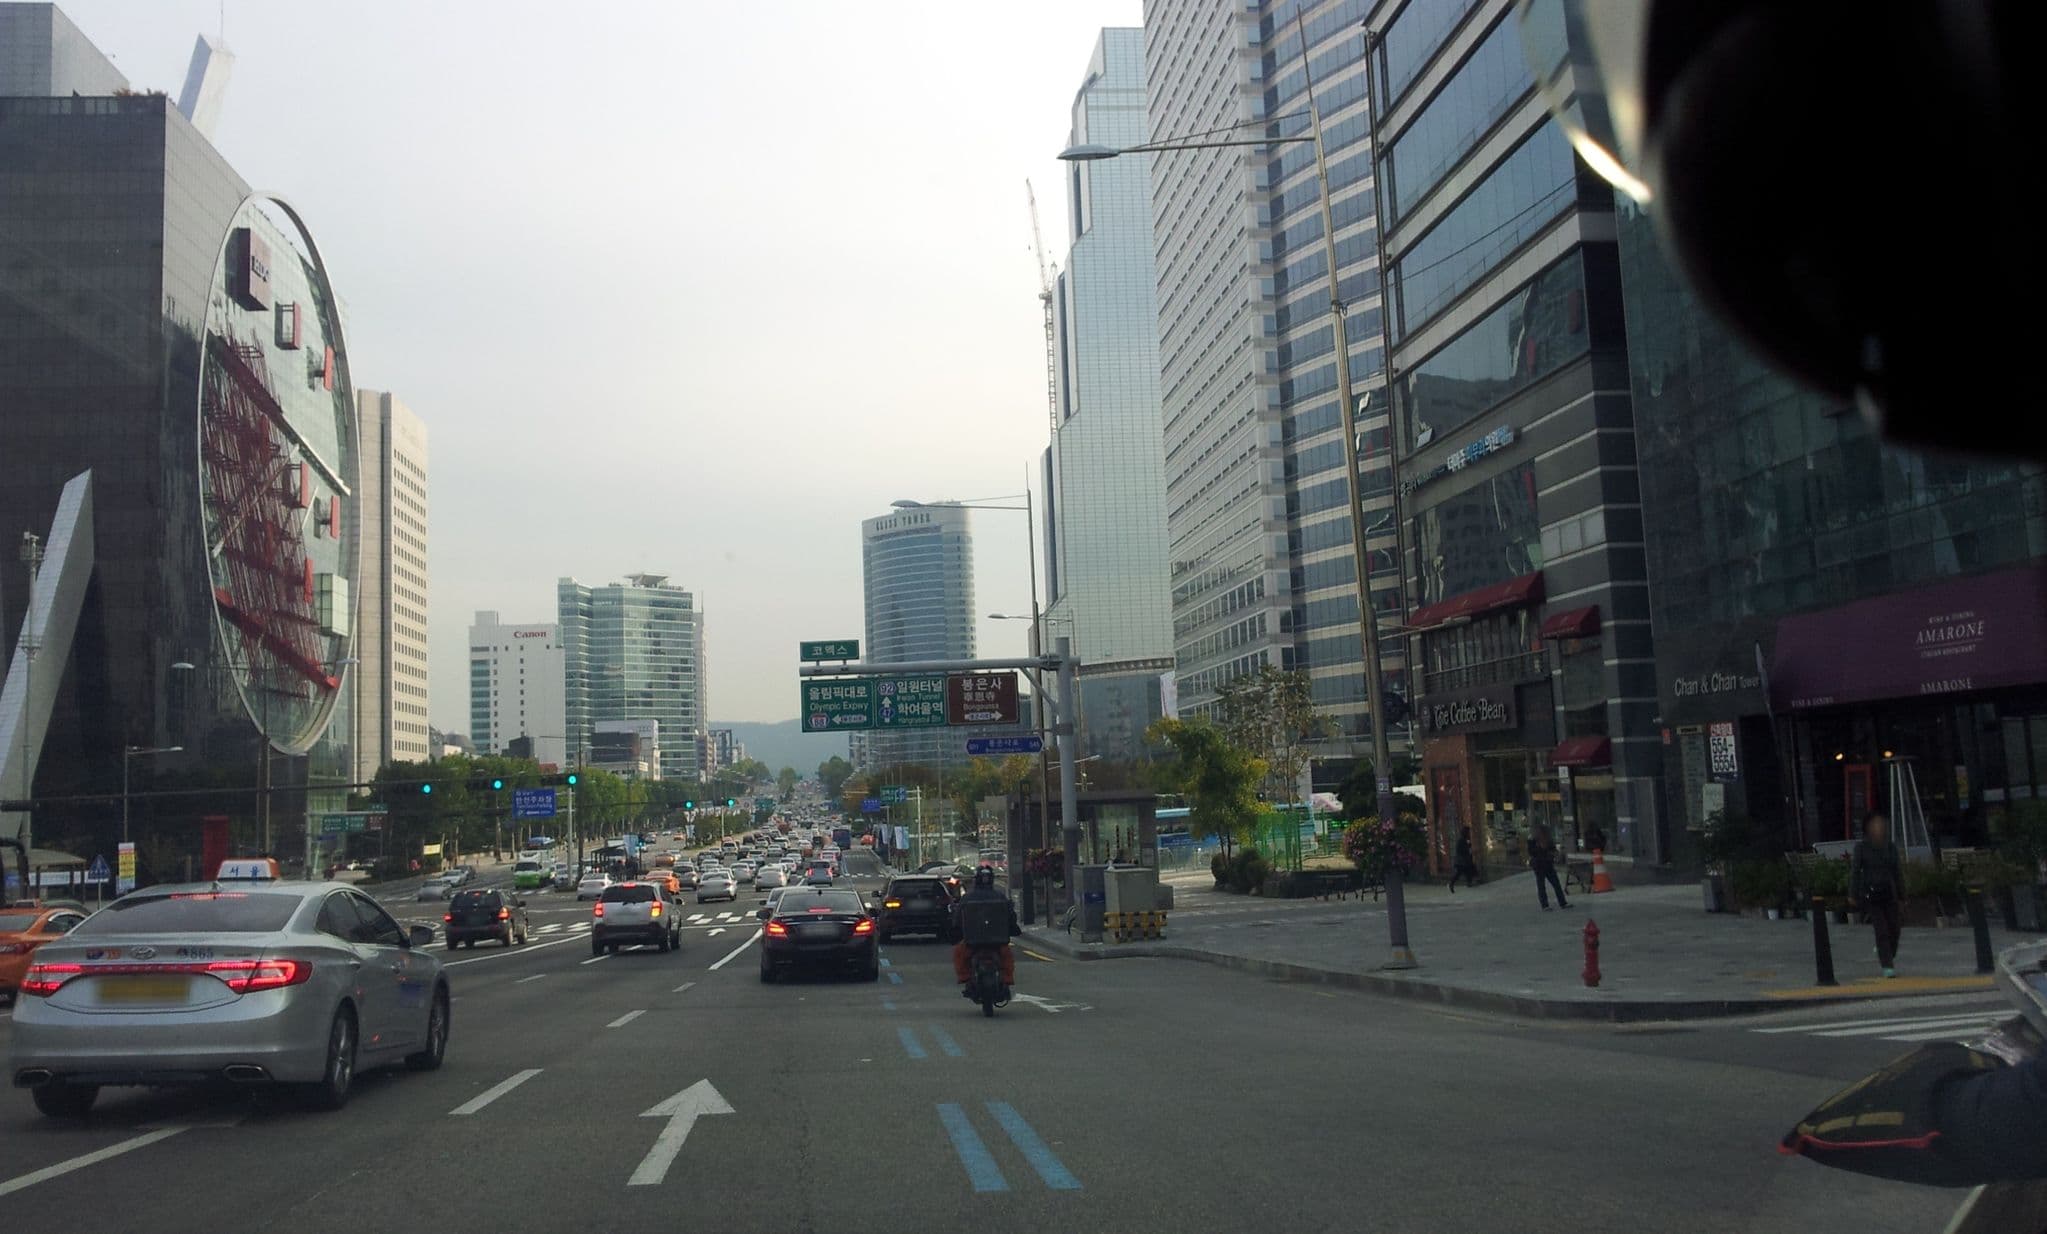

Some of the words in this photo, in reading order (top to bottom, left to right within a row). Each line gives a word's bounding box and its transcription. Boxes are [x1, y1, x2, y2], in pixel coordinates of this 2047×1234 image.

[902, 512, 930, 526] TOWER
[513, 631, 547, 639] Canon
[1916, 620, 1984, 644] AMARONE
[811, 645, 848, 656] 코엑스
[897, 680, 942, 693] 일원터널
[962, 677, 1001, 690] 봉은사
[1674, 677, 1698, 697] Chan
[1700, 675, 1709, 694] &
[1711, 672, 1737, 693] Chan
[1920, 678, 1972, 696] AMARONE
[808, 686, 868, 700] 올림픽대로
[809, 702, 840, 712] Olympic
[842, 701, 869, 712] Expwy
[897, 702, 943, 716] 학여울역
[1450, 700, 1477, 724] Coffee
[1477, 697, 1507, 724] Bean
[1712, 737, 1733, 754] 554-
[1713, 754, 1735, 771] 5554
[229, 866, 260, 878] 서울
